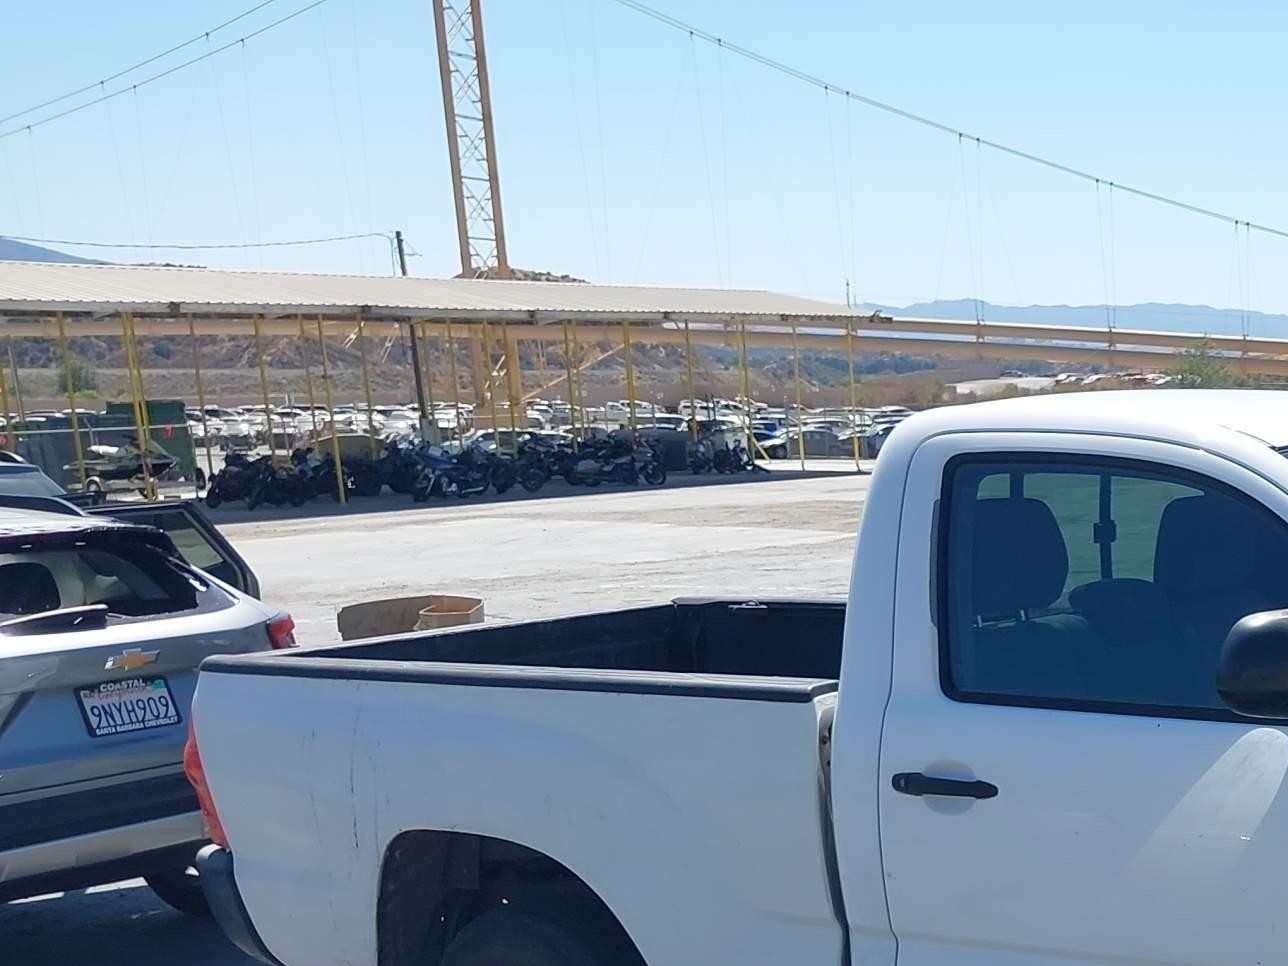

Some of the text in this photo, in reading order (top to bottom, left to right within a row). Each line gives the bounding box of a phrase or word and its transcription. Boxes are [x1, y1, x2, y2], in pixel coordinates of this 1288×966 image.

[100, 678, 146, 692] COASTAL
[90, 695, 169, 730] 9NYH909
[144, 716, 178, 727] CHEVROLET
